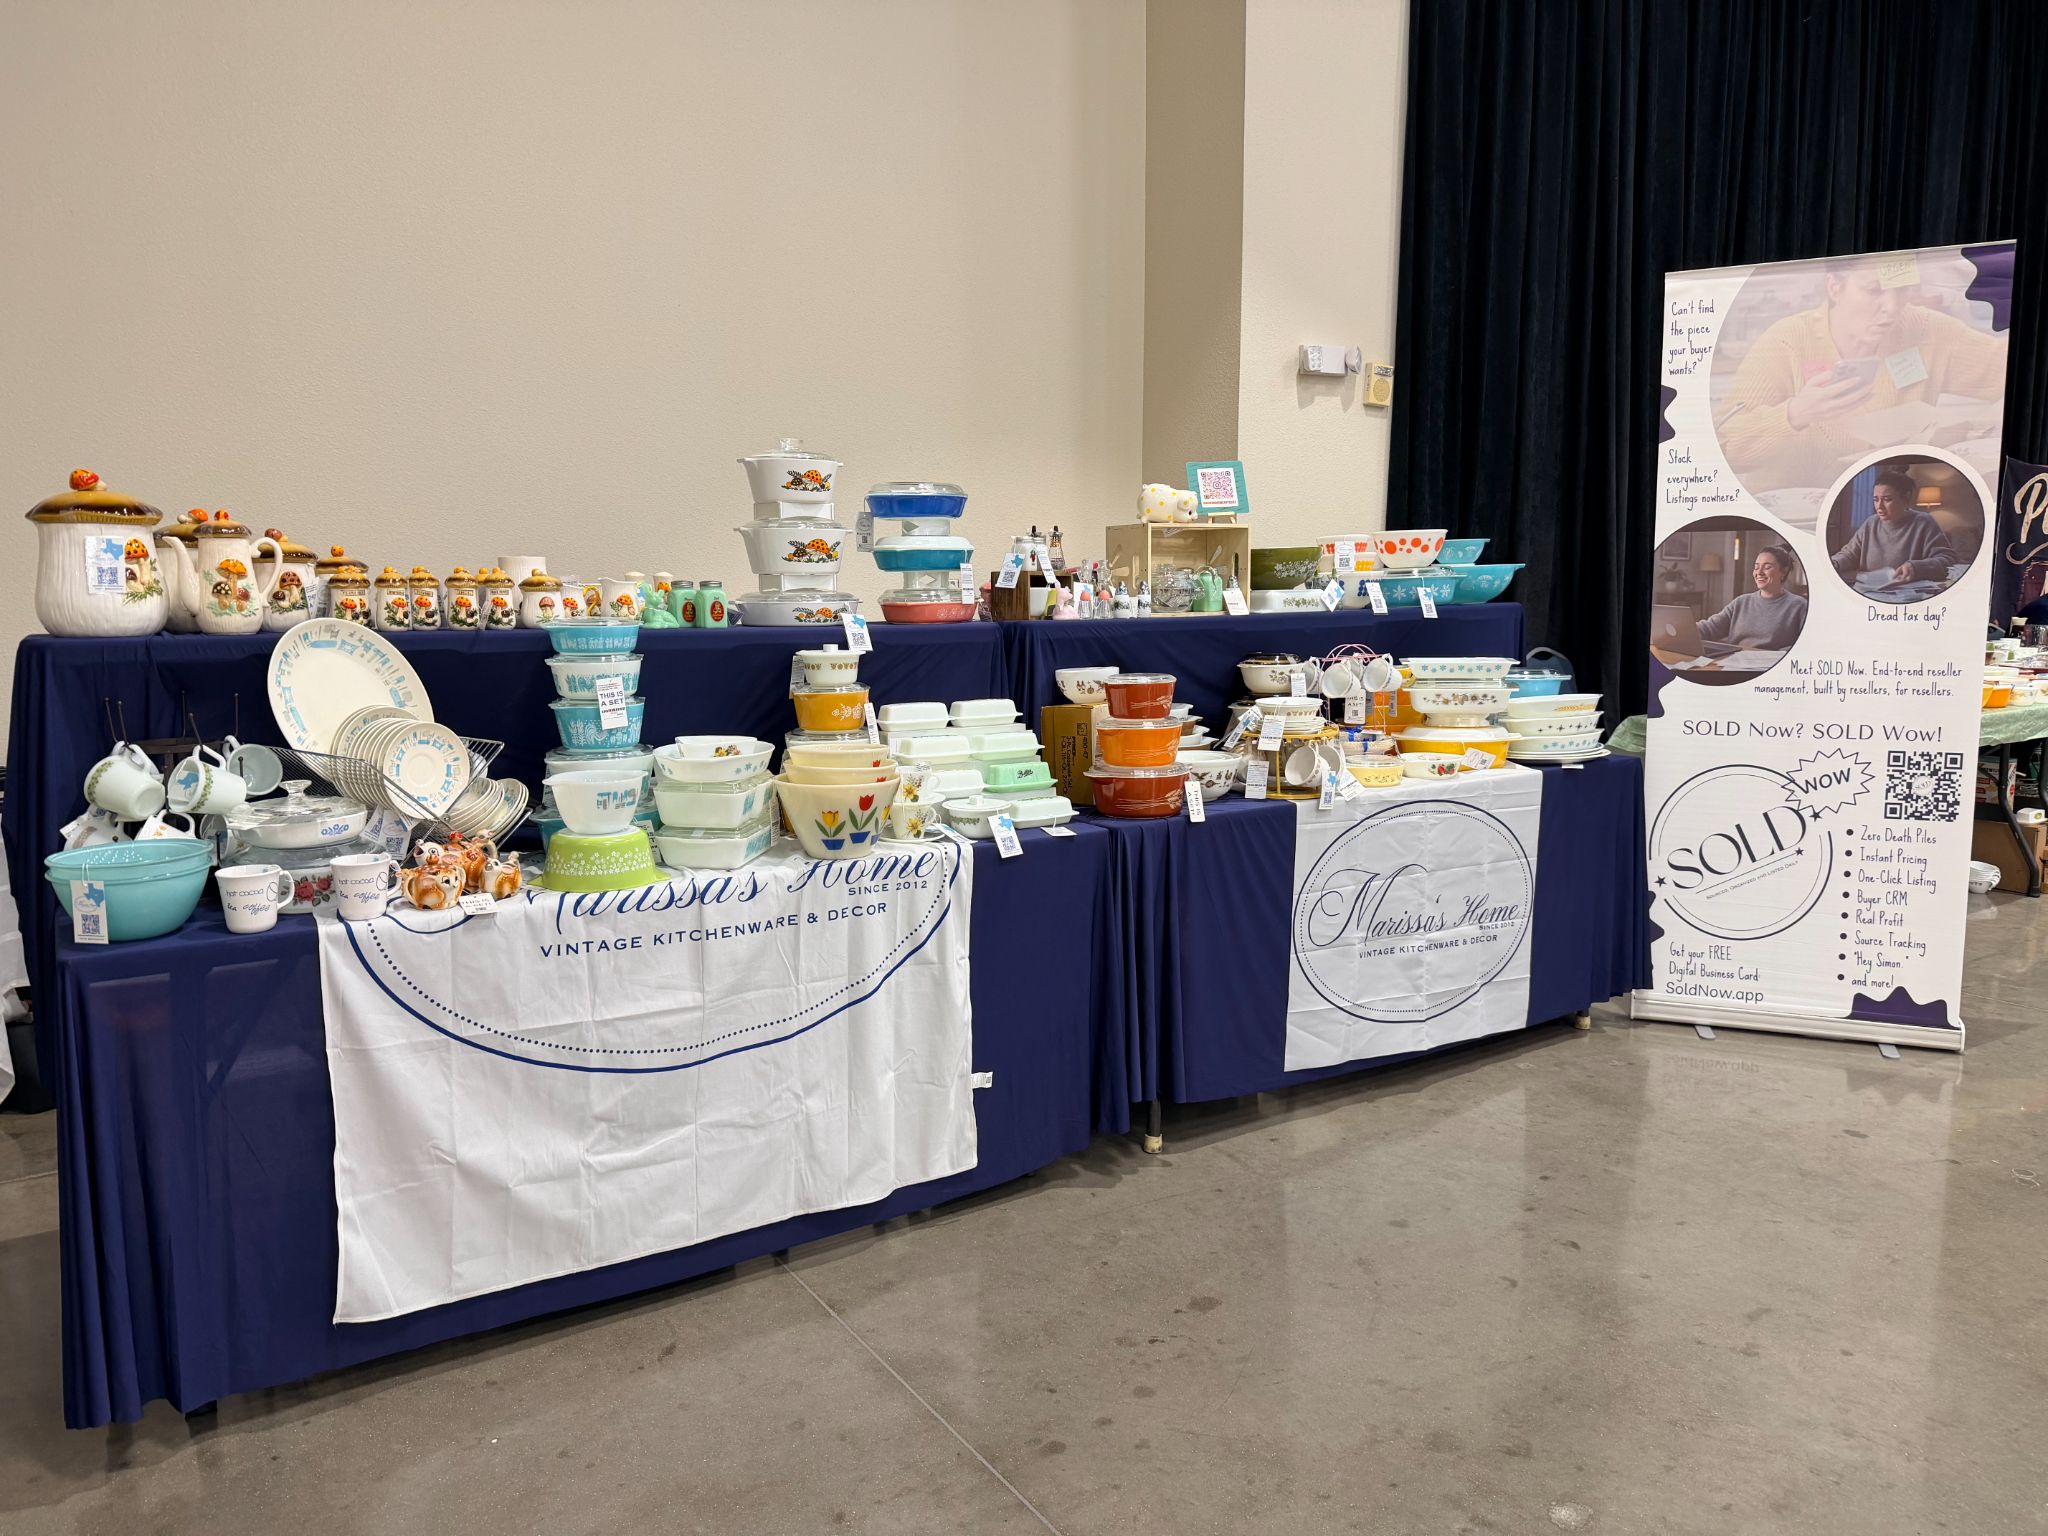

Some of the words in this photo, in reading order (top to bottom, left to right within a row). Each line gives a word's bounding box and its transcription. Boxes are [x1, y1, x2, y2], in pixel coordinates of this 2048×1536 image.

[1671, 300, 1694, 316] Can't
[1697, 299, 1715, 314] find
[1670, 320, 1684, 336] the
[1687, 326, 1711, 342] piece
[1668, 347, 1686, 364] your
[1689, 340, 1712, 361] buyer
[1668, 360, 1697, 376] wants?
[1668, 446, 1692, 464] Stock
[1667, 467, 1718, 491] everywhere?
[1666, 488, 1698, 511] Listings
[1701, 486, 1740, 503] nowhere?
[1867, 605, 1898, 622] Dread
[1903, 607, 1919, 622] tax
[1923, 607, 1947, 631] day?
[1790, 659, 1813, 675] Meet
[1816, 660, 1843, 675] SOLD
[1847, 660, 1867, 676] Now.
[1872, 660, 1923, 677] End-to-end
[1927, 662, 1963, 677] reseller
[599, 691, 616, 700] THIS
[1813, 679, 1834, 695] built
[1836, 680, 1847, 702] by
[1895, 681, 1909, 695] for
[1911, 682, 1954, 697] resellers.
[608, 698, 624, 706] SET
[1682, 720, 1741, 737] SOLD
[1749, 721, 1803, 739] Now?
[1812, 723, 1874, 740] SOLD
[1882, 725, 1943, 742] Wow!
[1800, 767, 1851, 795] WOW
[1860, 824, 1881, 841] Zero
[1884, 827, 1912, 843] Death
[1915, 827, 1937, 844] Piles
[1667, 805, 1807, 889] SOLD
[1860, 846, 1893, 863] Instant
[1897, 848, 1928, 872] Pricing
[350, 877, 374, 885] cocoa
[848, 883, 889, 895] SINCE
[895, 880, 928, 891] 2012
[1857, 868, 1903, 885] One-Click
[1906, 870, 1937, 894] Listing
[225, 889, 237, 897] hot
[239, 888, 264, 897] cocoa
[1857, 889, 1882, 912] Buyer
[1885, 890, 1908, 906] CRM
[242, 903, 271, 915] coffee
[1308, 863, 1447, 947] Marissa's
[1453, 892, 1520, 928] Home
[1479, 923, 1499, 931] SINCE
[1500, 921, 1515, 929] 2012
[1855, 908, 1875, 925] Real
[1879, 910, 1904, 927] Profit
[540, 936, 643, 958] VINTAGE
[653, 914, 798, 946] KITCHENWARE
[806, 912, 819, 924] &
[828, 902, 887, 921] DECOR
[1359, 946, 1396, 959] VINTAGE
[1399, 939, 1460, 954] KITCHENWARE
[1462, 938, 1468, 946] &
[1470, 934, 1498, 945] DECOR
[1669, 941, 1685, 957] Get
[1688, 951, 1705, 965] your
[1708, 944, 1732, 961] FREE
[1854, 929, 1884, 946] Source
[1888, 932, 1927, 957] Tracking
[1668, 960, 1697, 982] Digital
[1700, 963, 1735, 979] Business
[1851, 973, 1867, 987] and
[1871, 974, 1894, 988] more!
[1665, 981, 1764, 1005] SoldNow.app
